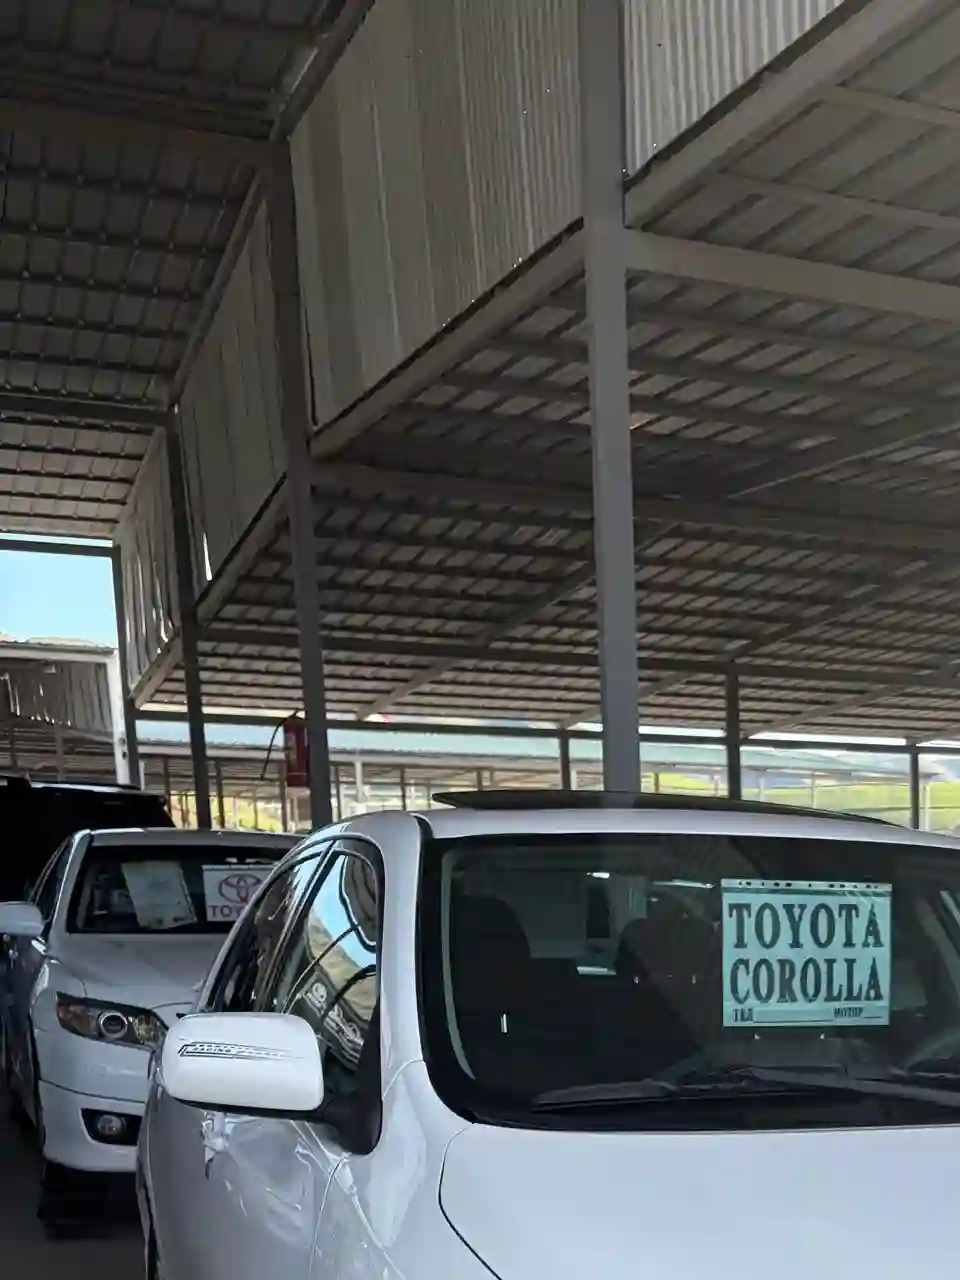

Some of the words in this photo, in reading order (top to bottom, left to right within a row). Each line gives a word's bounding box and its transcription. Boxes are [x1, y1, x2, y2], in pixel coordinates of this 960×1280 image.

[207, 904, 245, 917] TOY
[728, 902, 884, 949] TOYOTA
[730, 956, 884, 1004] COROLLA
